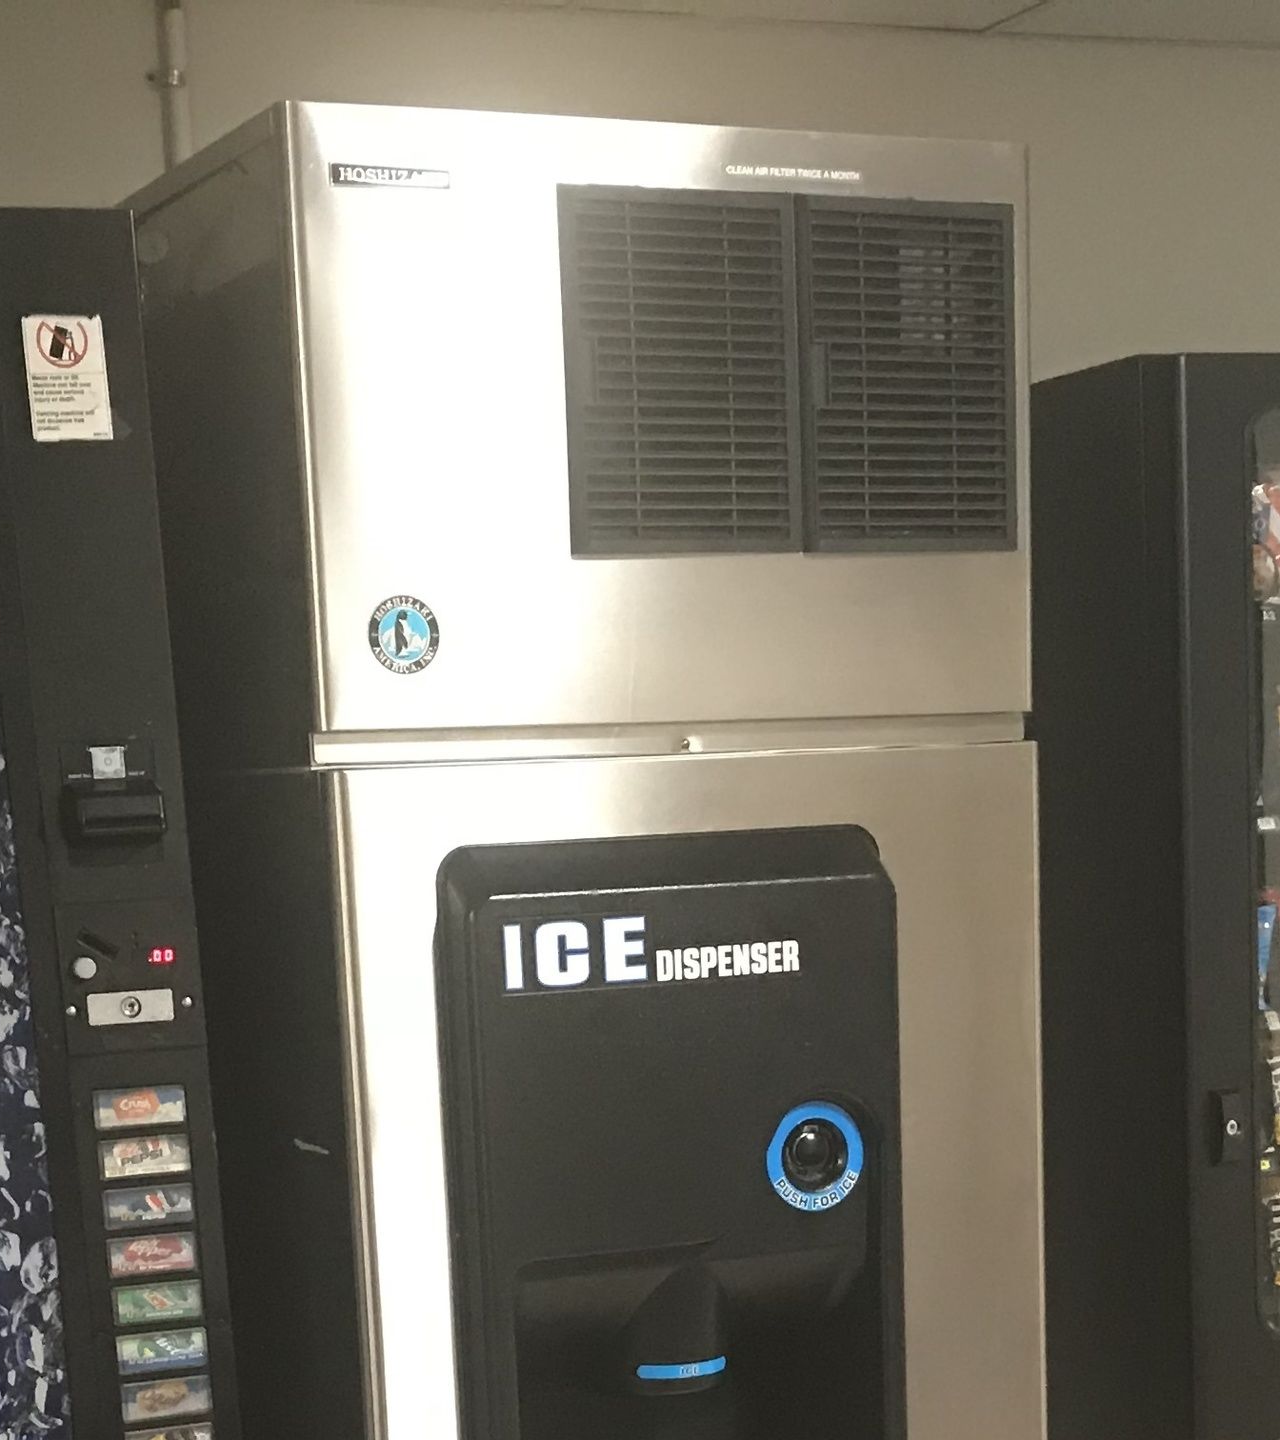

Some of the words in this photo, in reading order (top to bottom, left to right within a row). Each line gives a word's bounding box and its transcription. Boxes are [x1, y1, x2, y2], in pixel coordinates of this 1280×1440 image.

[338, 166, 432, 185] HOSHIZA
[726, 165, 753, 176] CLEAN
[755, 166, 768, 176] AIR
[770, 167, 795, 177] FILTER
[797, 168, 821, 178] TWICE
[823, 170, 829, 178] A
[831, 171, 859, 180] MONTH
[503, 916, 648, 990] ICE
[656, 940, 800, 982] DISPENSER
[120, 1148, 163, 1168] PEPSI
[775, 1179, 808, 1207] PUSH
[813, 1192, 839, 1208] FOR
[841, 1171, 857, 1194] ICE
